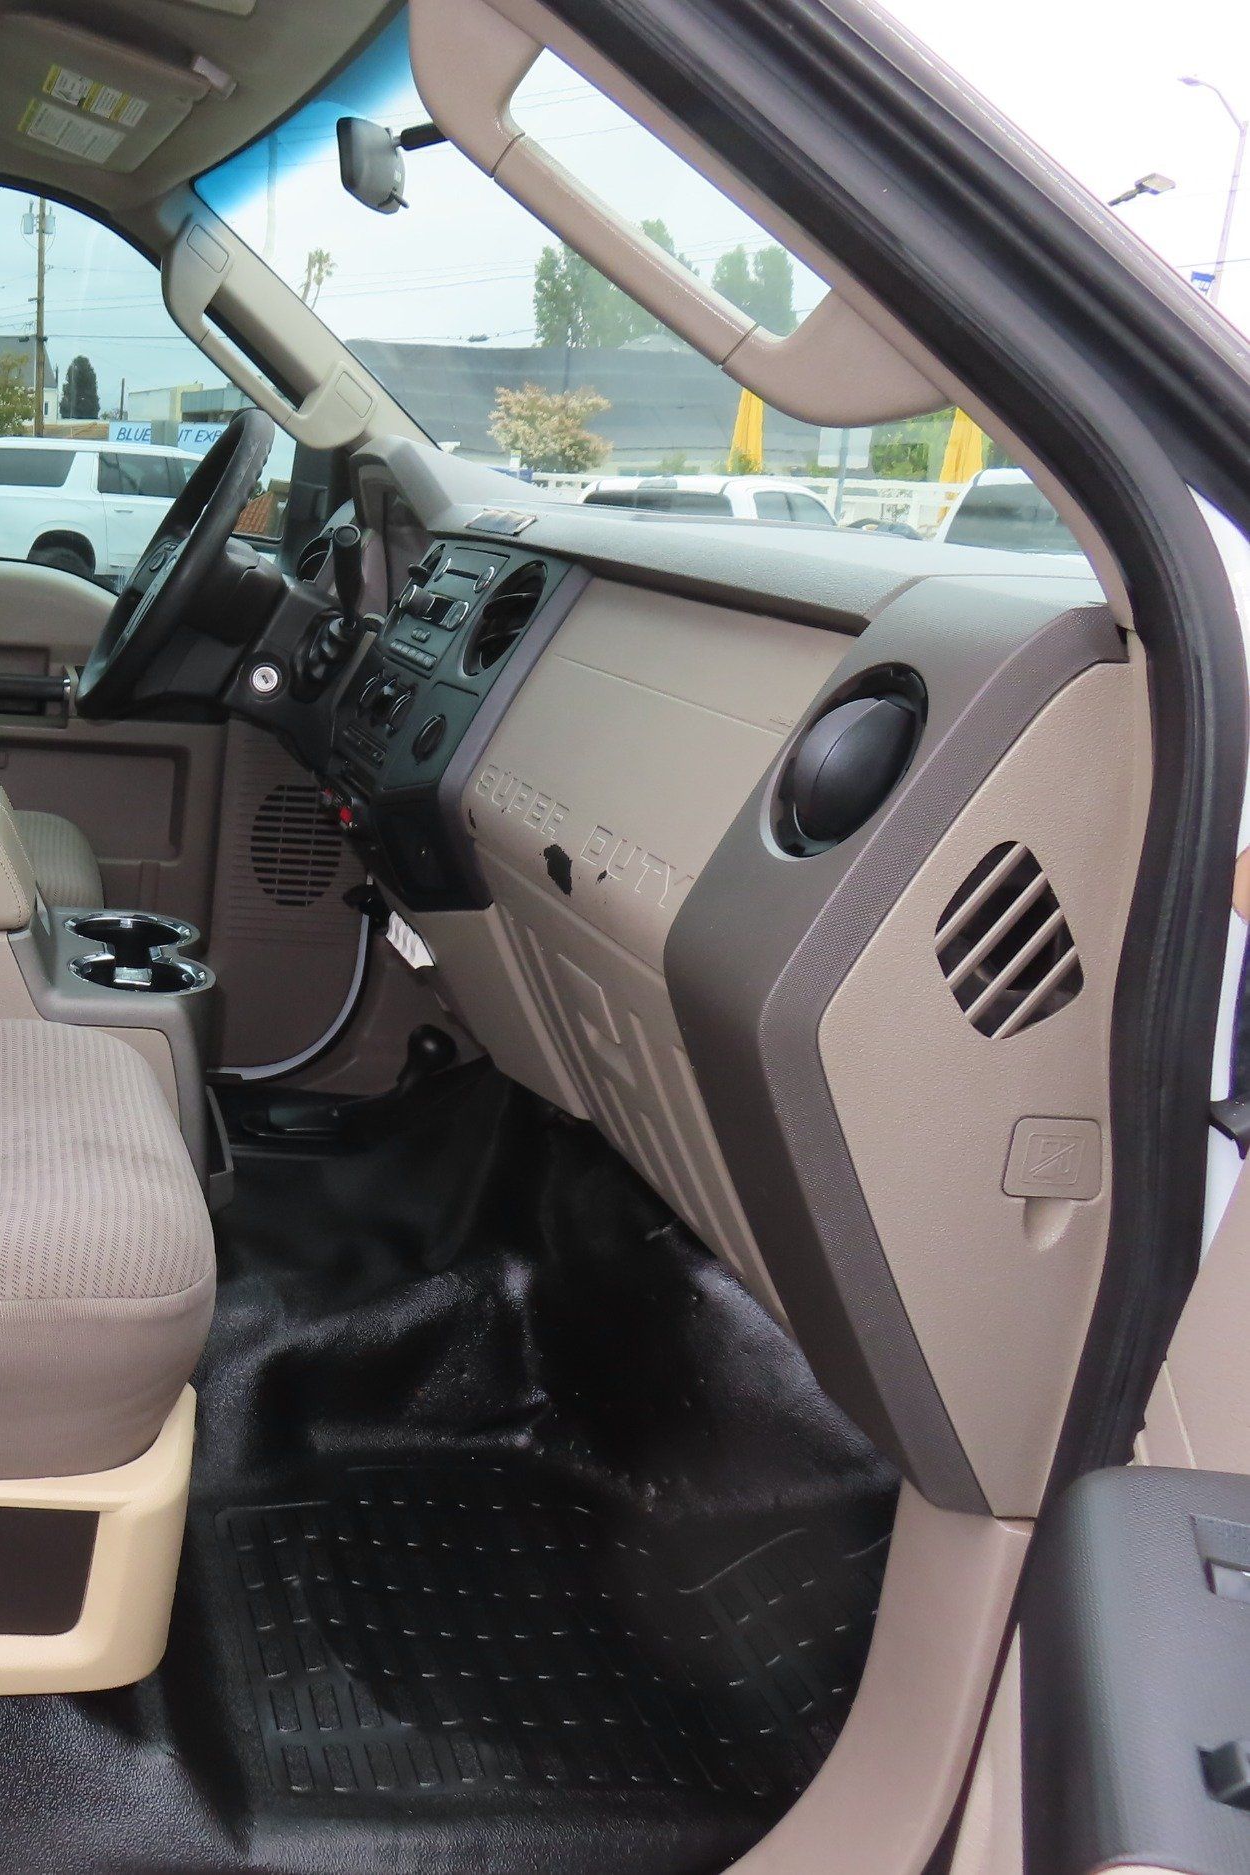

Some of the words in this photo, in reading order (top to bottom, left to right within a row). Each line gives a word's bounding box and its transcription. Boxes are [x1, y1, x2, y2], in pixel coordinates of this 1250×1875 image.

[116, 427, 152, 441] BLUE
[476, 764, 569, 841] SUPER
[580, 825, 694, 908] DUTY
